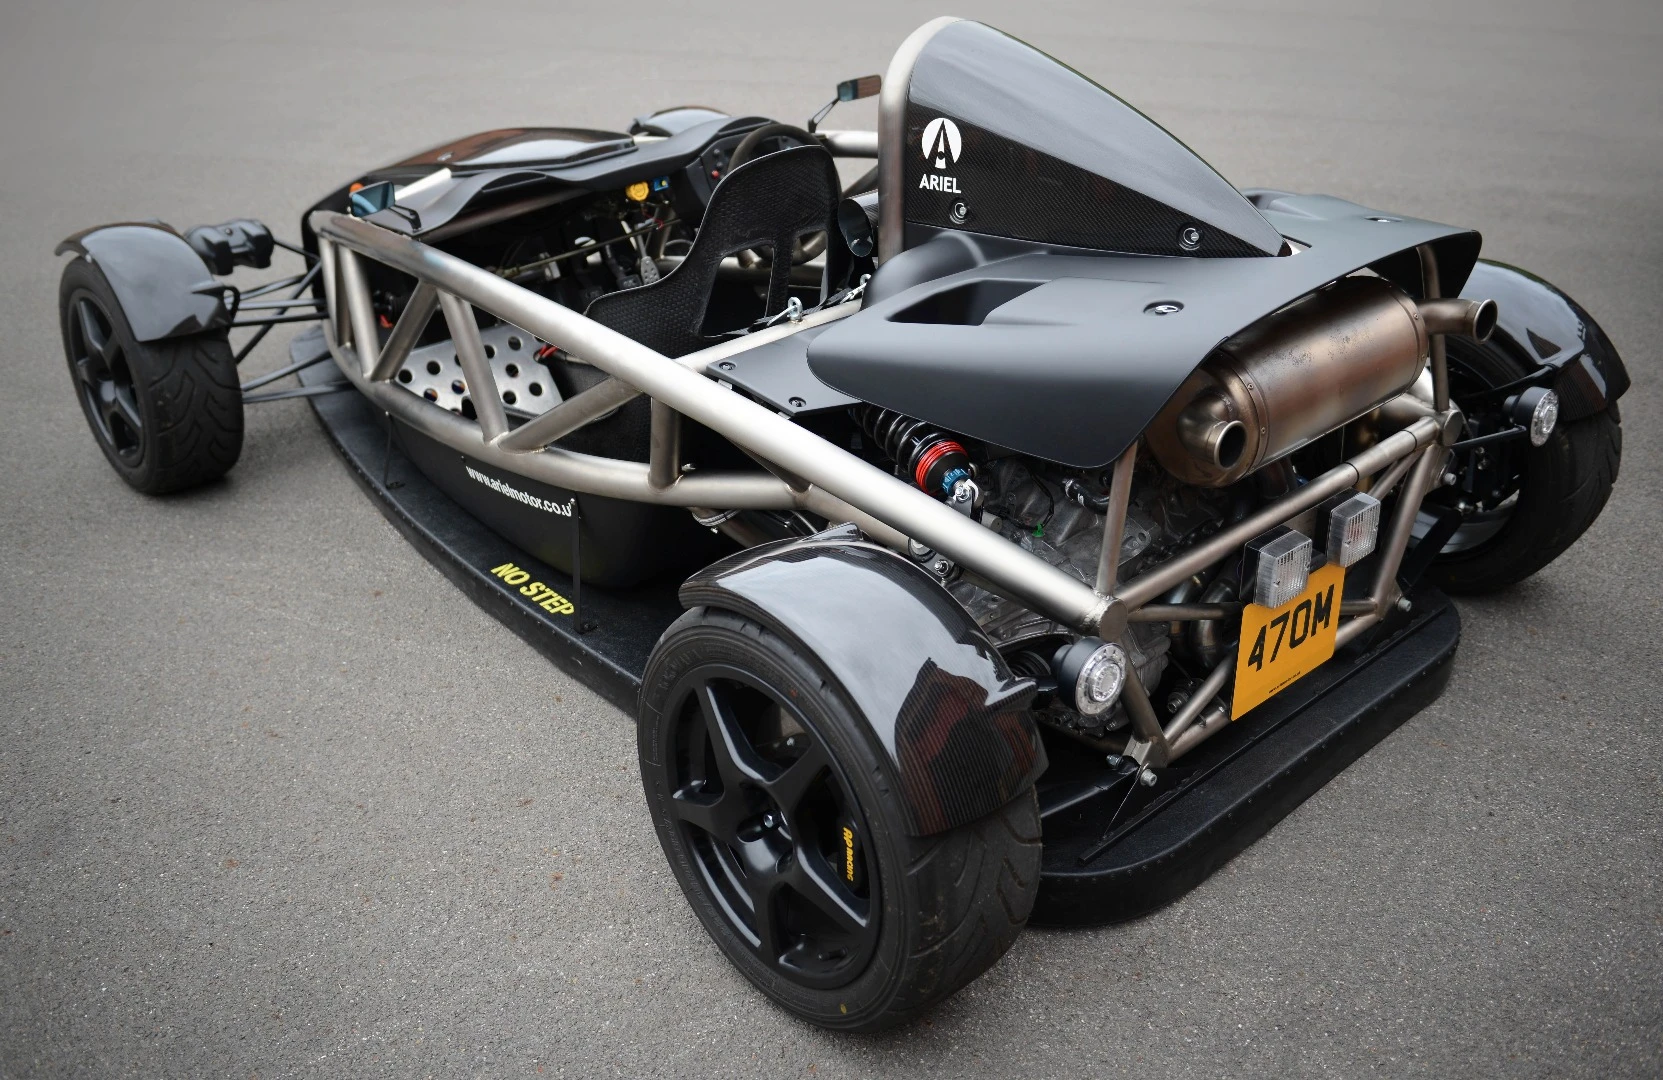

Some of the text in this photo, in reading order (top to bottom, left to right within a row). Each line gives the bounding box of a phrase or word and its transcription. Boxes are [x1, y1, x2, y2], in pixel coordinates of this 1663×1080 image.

[919, 173, 961, 193] ARIEL
[466, 466, 573, 517] www.arielmotor.co.u
[490, 562, 575, 615] NO STEP
[1248, 584, 1334, 672] 470M
[843, 827, 853, 848] AP
